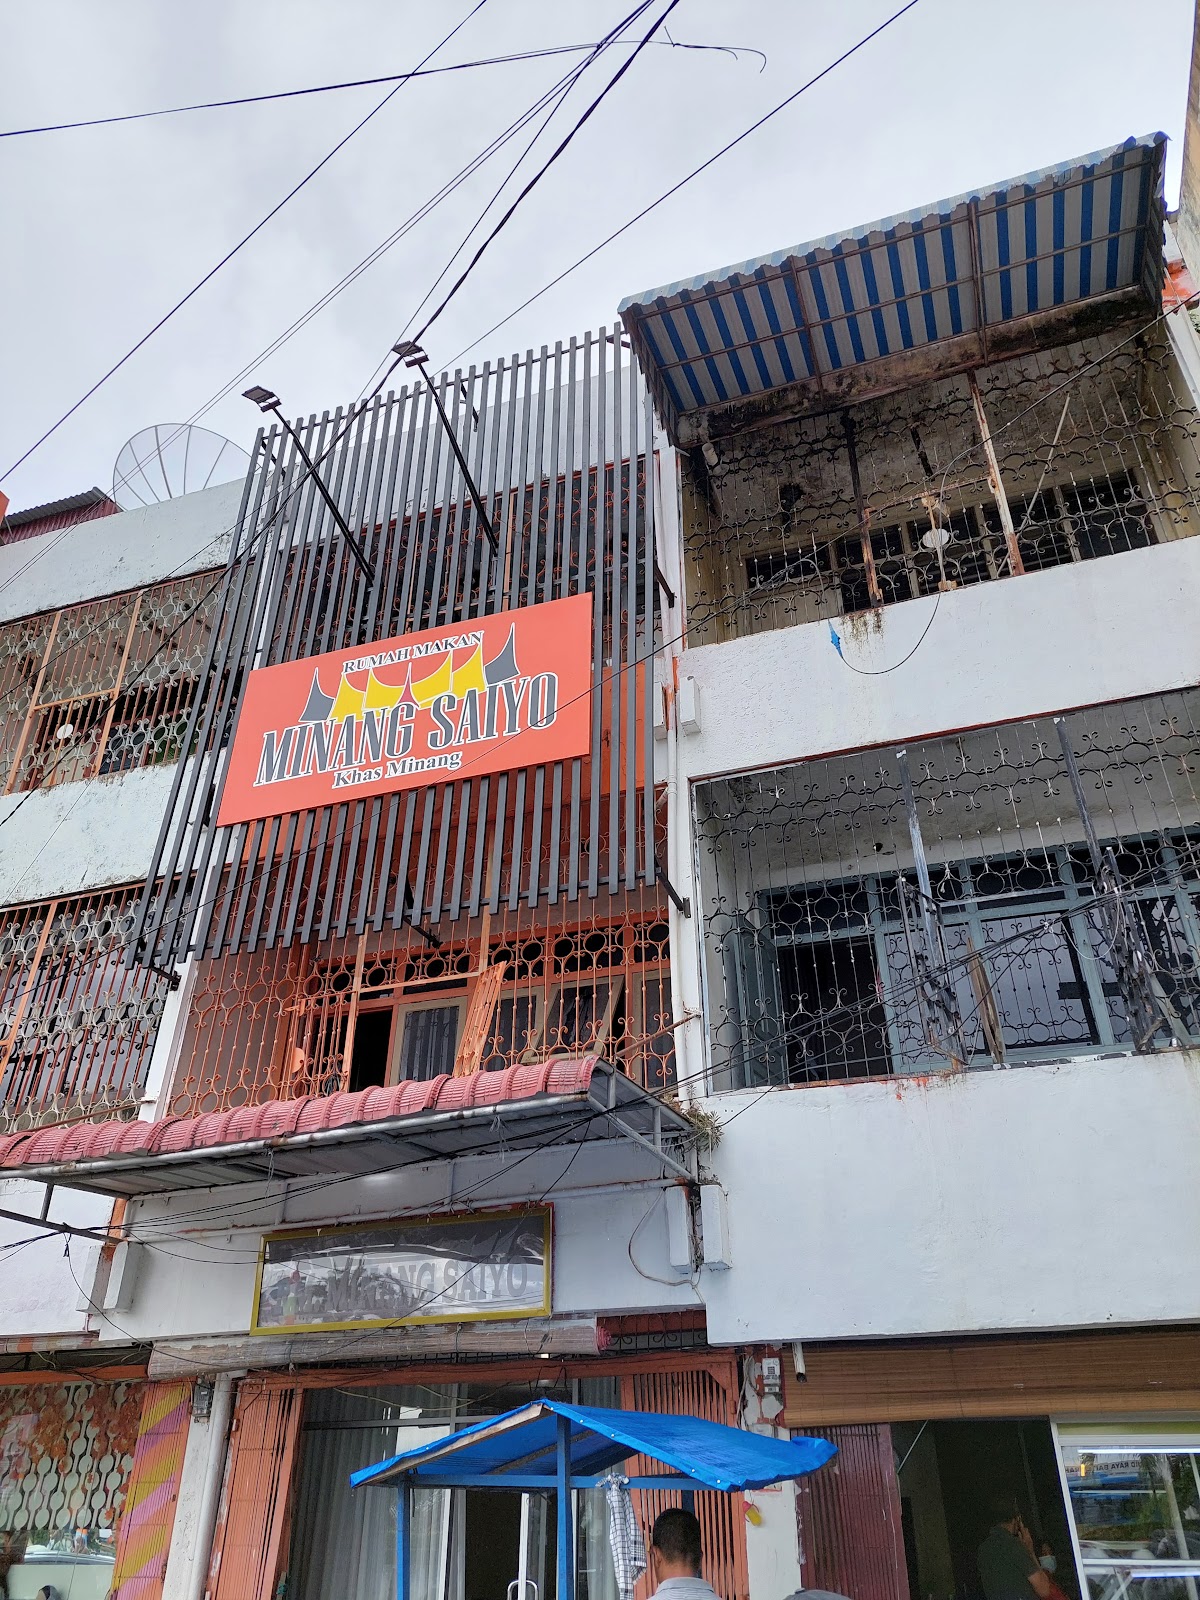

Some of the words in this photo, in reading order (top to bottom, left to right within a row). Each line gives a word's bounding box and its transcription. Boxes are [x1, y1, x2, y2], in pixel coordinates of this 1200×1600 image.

[343, 647, 410, 674] RUMAH
[412, 630, 484, 659] MAKAN
[253, 703, 415, 787] MINANG
[428, 672, 558, 749] SAIYO
[332, 767, 382, 788] Khas
[385, 751, 462, 779] Minang
[442, 1256, 527, 1303] SAIYO
